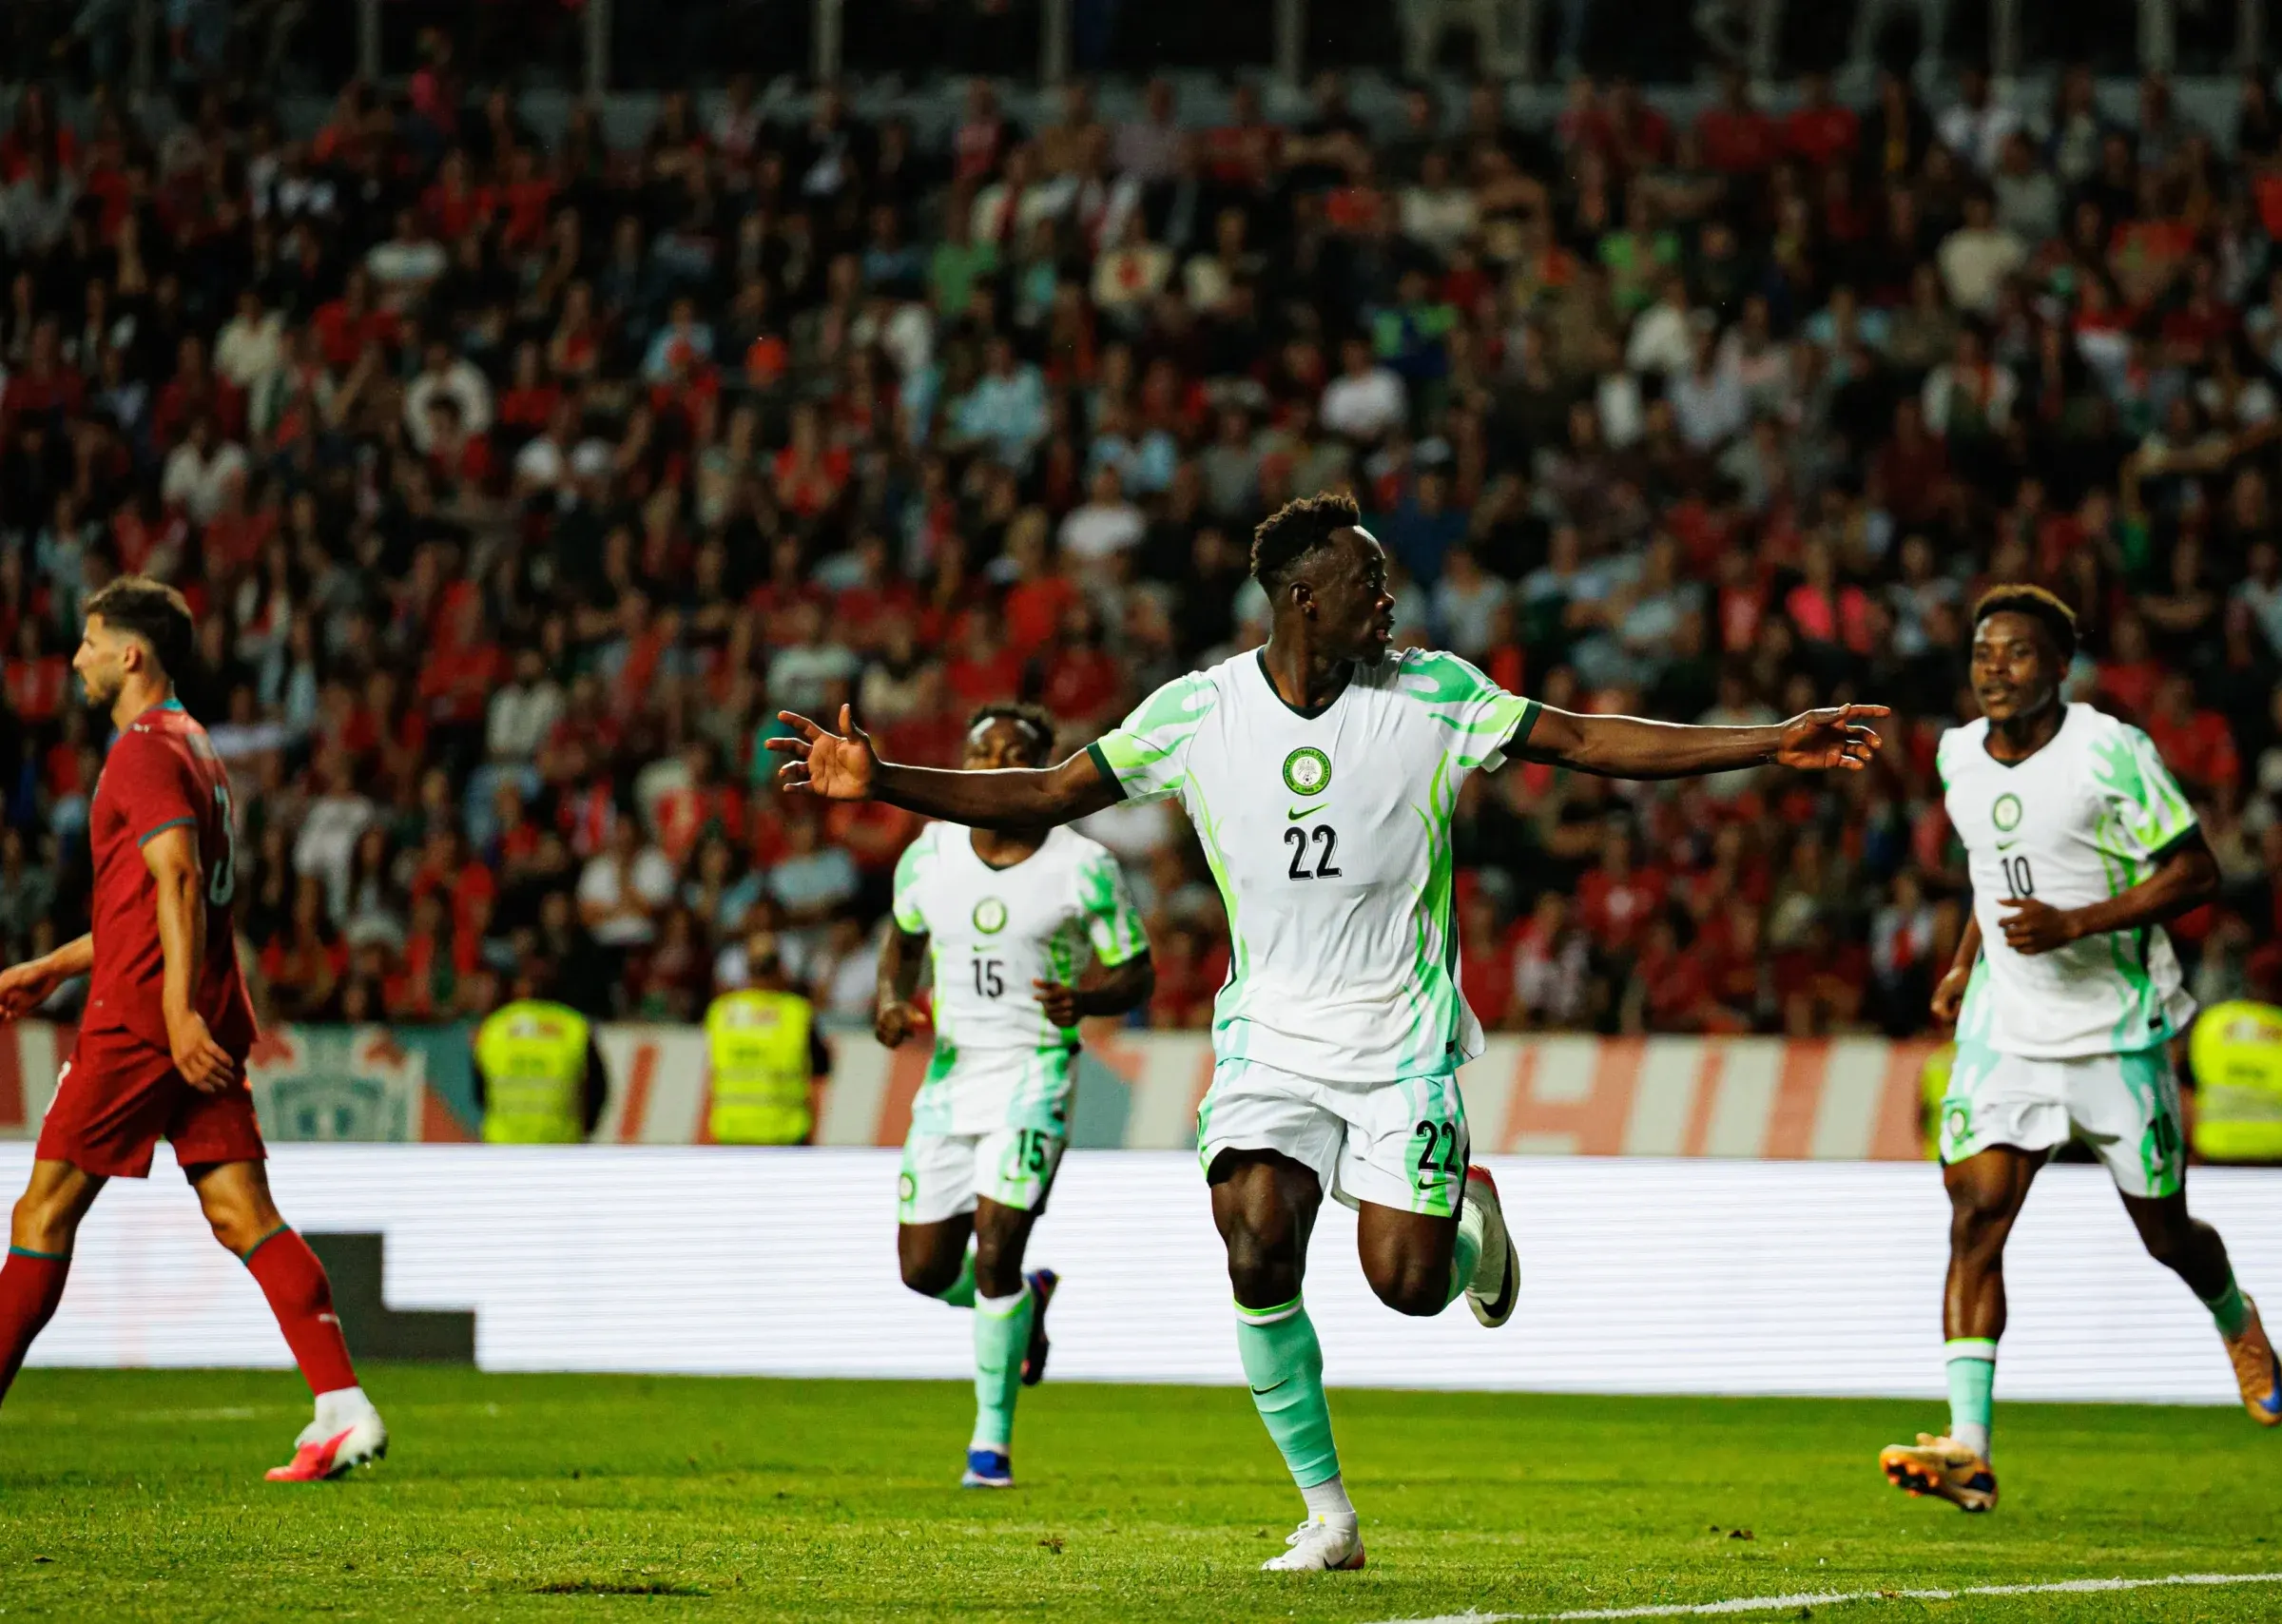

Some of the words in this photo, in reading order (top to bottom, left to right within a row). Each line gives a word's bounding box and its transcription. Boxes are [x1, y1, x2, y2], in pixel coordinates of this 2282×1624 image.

[1284, 824, 1342, 880] 22
[2000, 856, 2033, 899] 10
[972, 958, 1004, 997] 15
[1017, 1129, 1049, 1171] 15
[1416, 1119, 1458, 1174] 22
